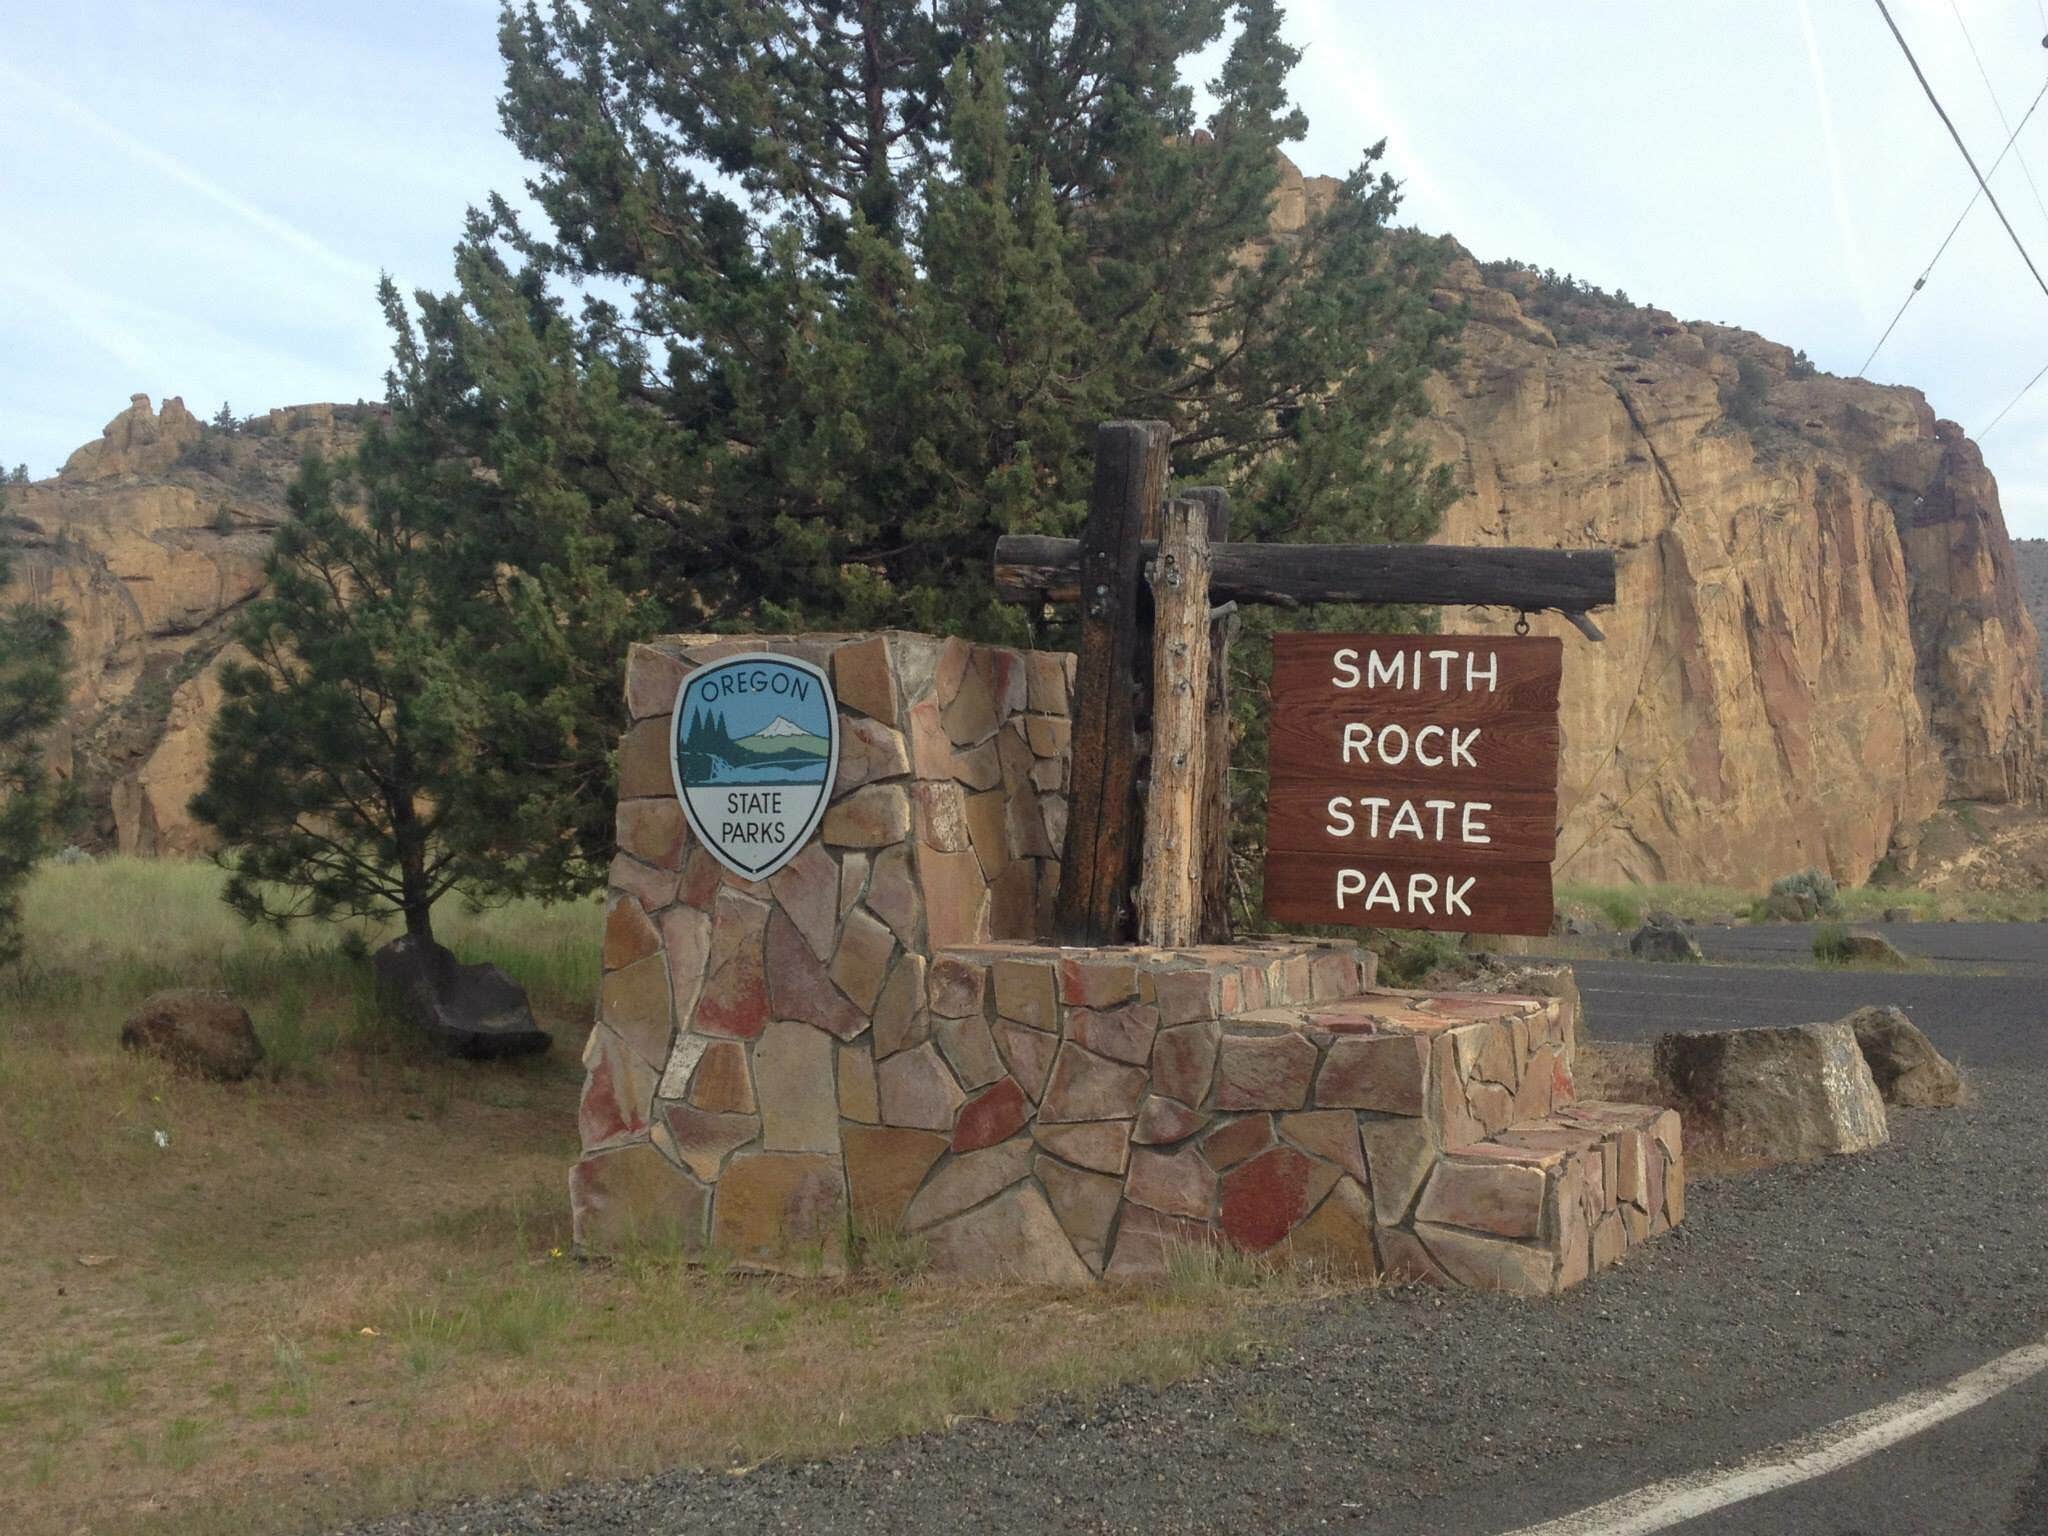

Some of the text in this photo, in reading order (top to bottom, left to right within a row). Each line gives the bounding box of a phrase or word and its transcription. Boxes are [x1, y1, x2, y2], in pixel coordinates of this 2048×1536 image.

[701, 670, 809, 702] OREGON
[1332, 648, 1497, 692] SMITH
[1342, 723, 1481, 767] ROCK
[727, 792, 782, 814] STATE
[1326, 796, 1492, 843] STATE
[722, 822, 785, 843] PARKS
[1336, 869, 1476, 916] PARK
